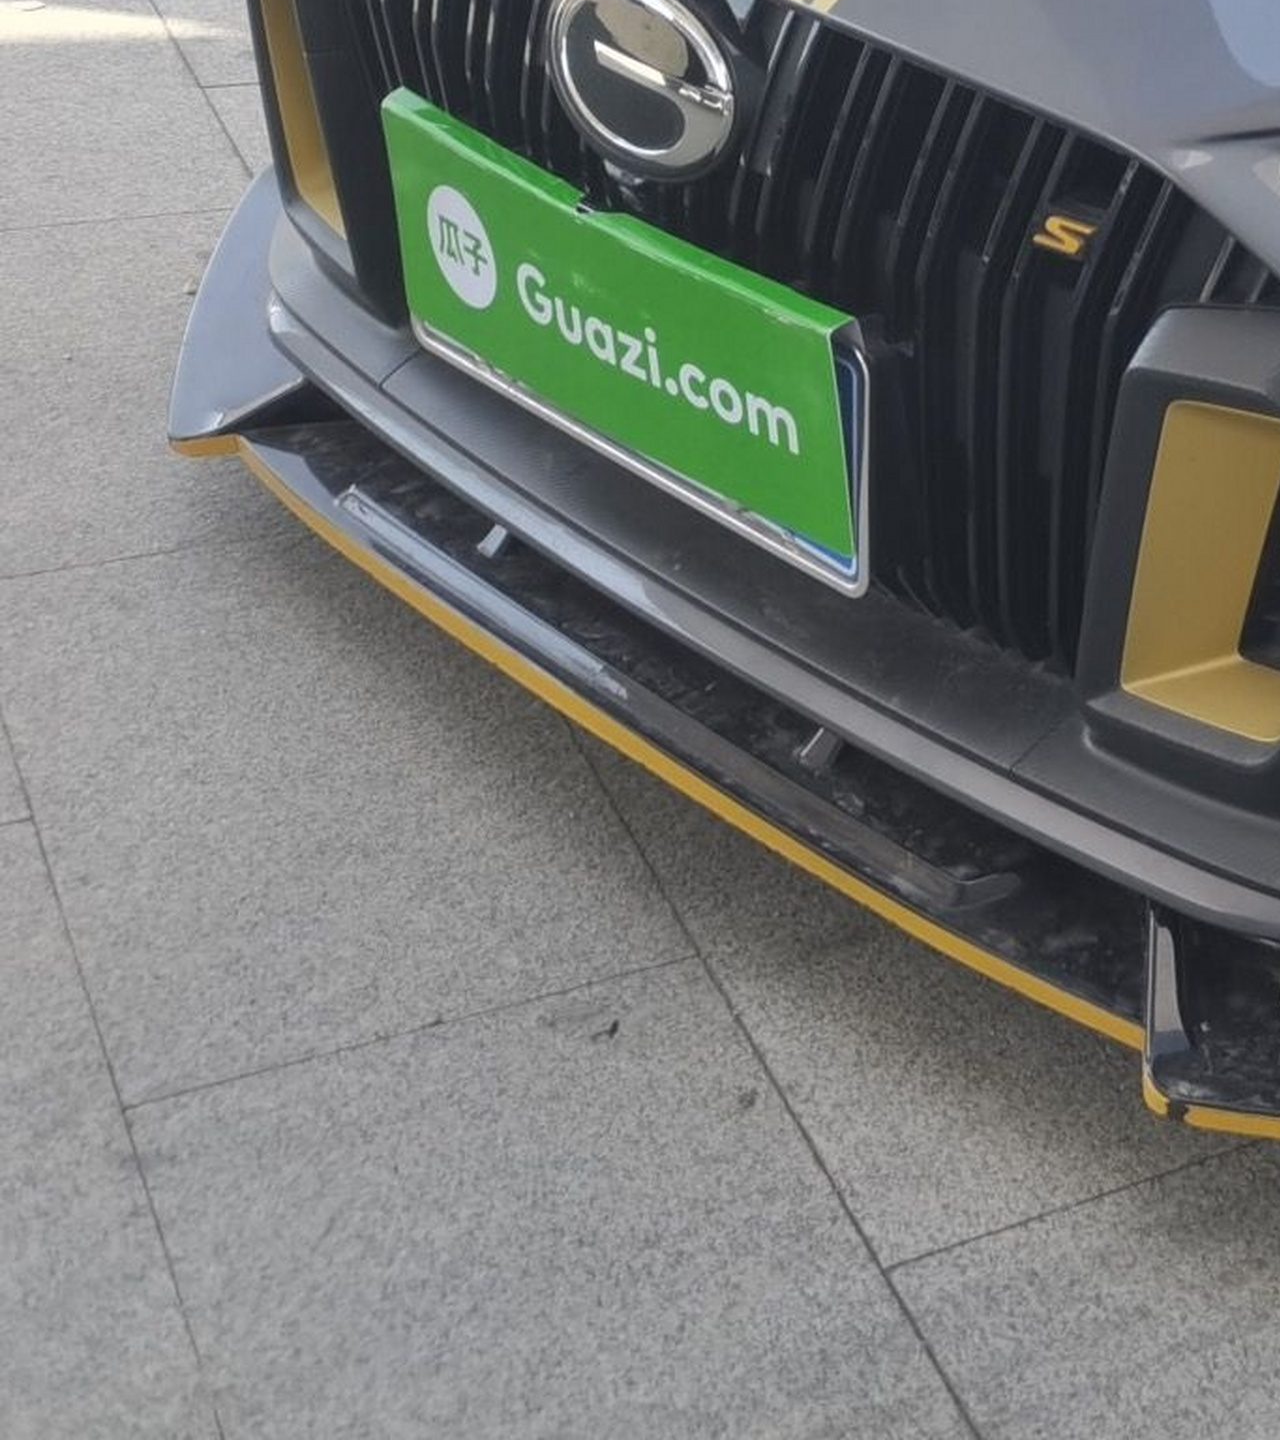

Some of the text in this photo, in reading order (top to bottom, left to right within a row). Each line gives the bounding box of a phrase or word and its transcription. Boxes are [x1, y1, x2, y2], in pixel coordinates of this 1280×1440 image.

[1032, 214, 1098, 256] S
[438, 213, 800, 456] 瓜子 Guazi.com
